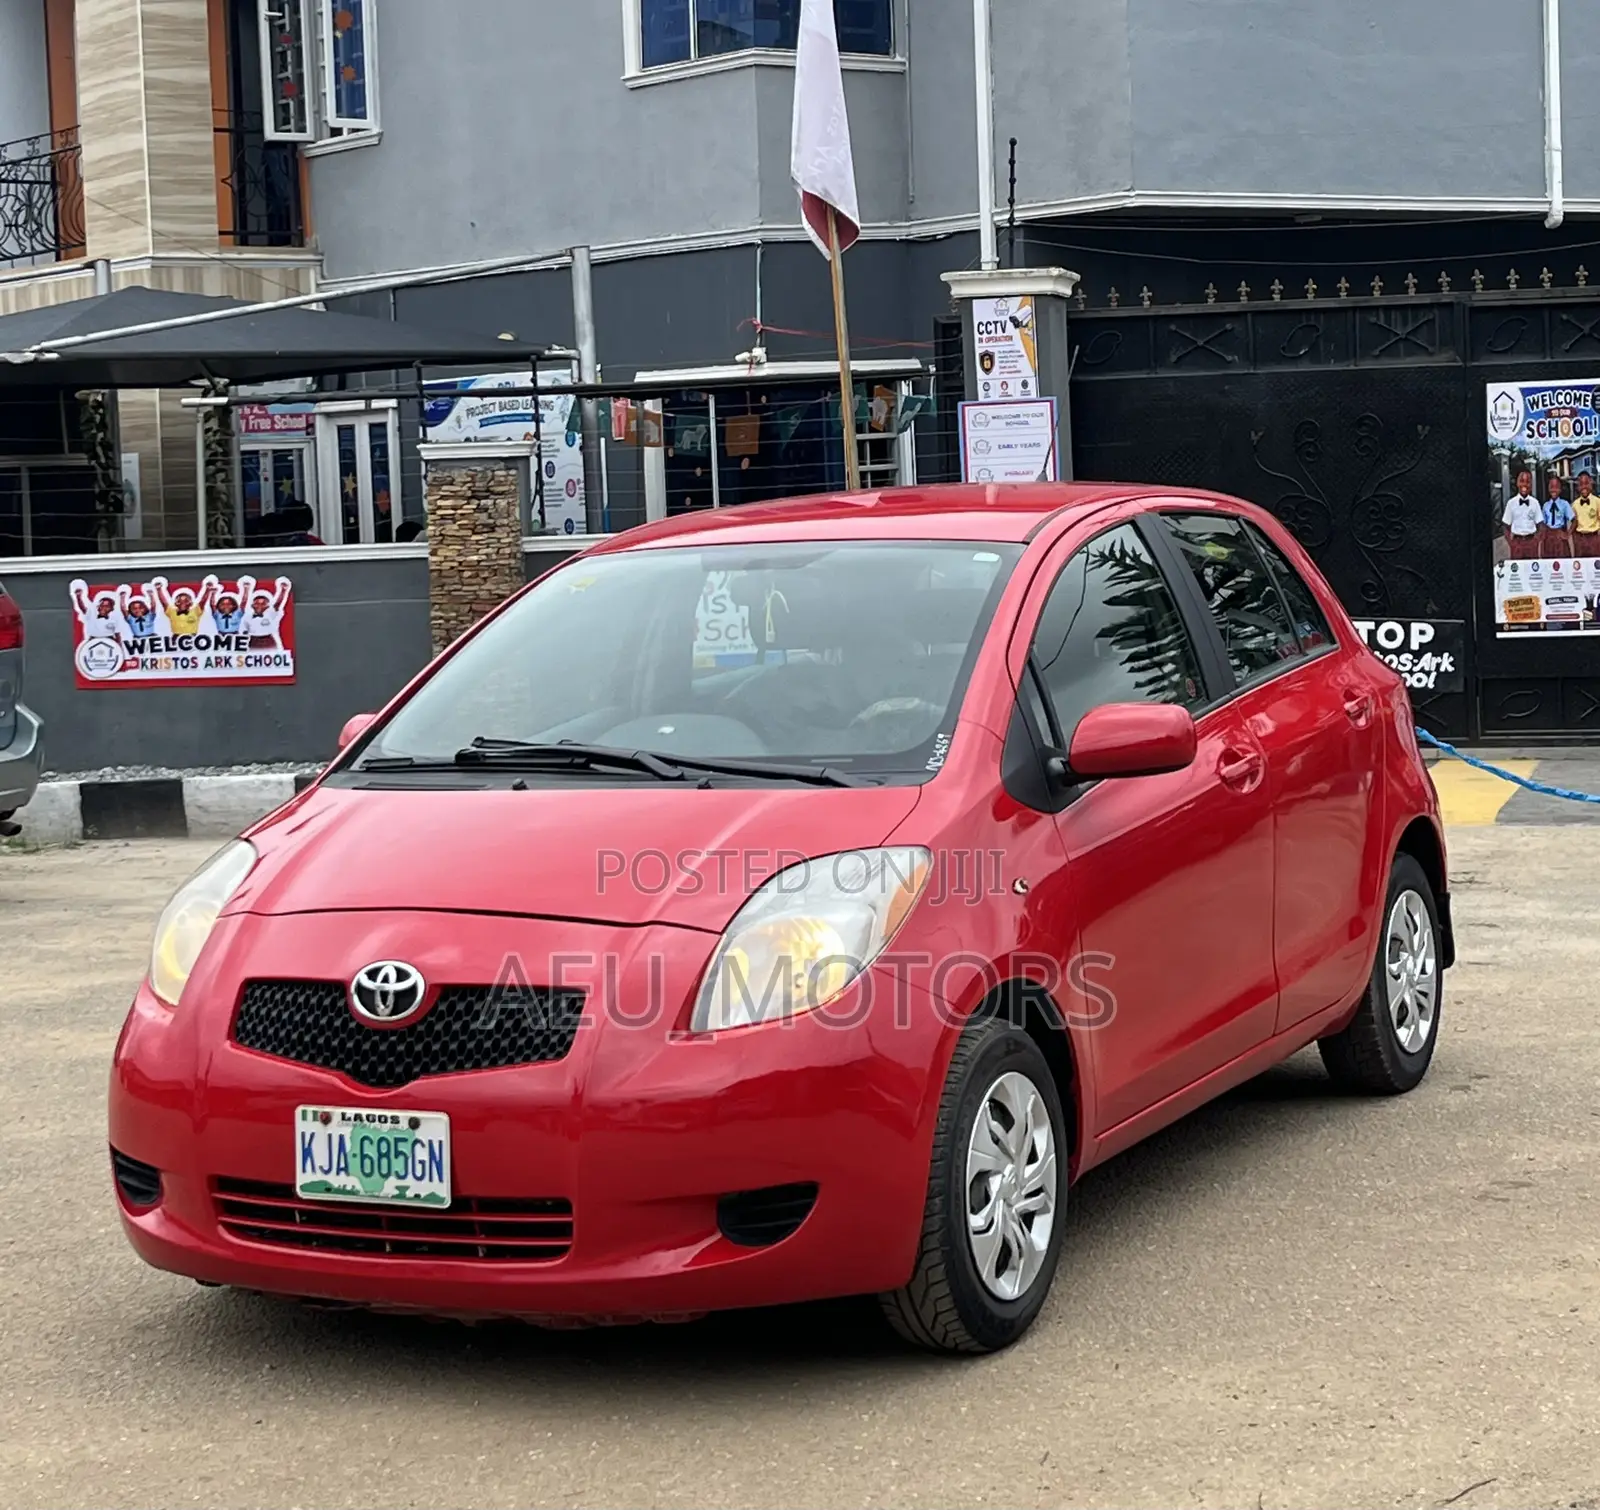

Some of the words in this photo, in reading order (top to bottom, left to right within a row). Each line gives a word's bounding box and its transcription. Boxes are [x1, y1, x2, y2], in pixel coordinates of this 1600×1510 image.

[977, 320, 1007, 335] CCTV
[465, 403, 496, 418] PROJECT
[498, 400, 521, 411] BASED
[521, 399, 554, 411] LEANING
[1527, 391, 1590, 411] WELCOME
[248, 415, 272, 430] Free
[274, 414, 306, 429] School
[1526, 417, 1598, 438] SCHOOL!
[124, 634, 249, 656] WELCOME
[1352, 621, 1435, 650] TOP
[141, 657, 199, 671] KRISTOS
[204, 656, 233, 669] ARK
[236, 653, 290, 667] SCHOOL
[341, 1111, 401, 1125] LAGOS
